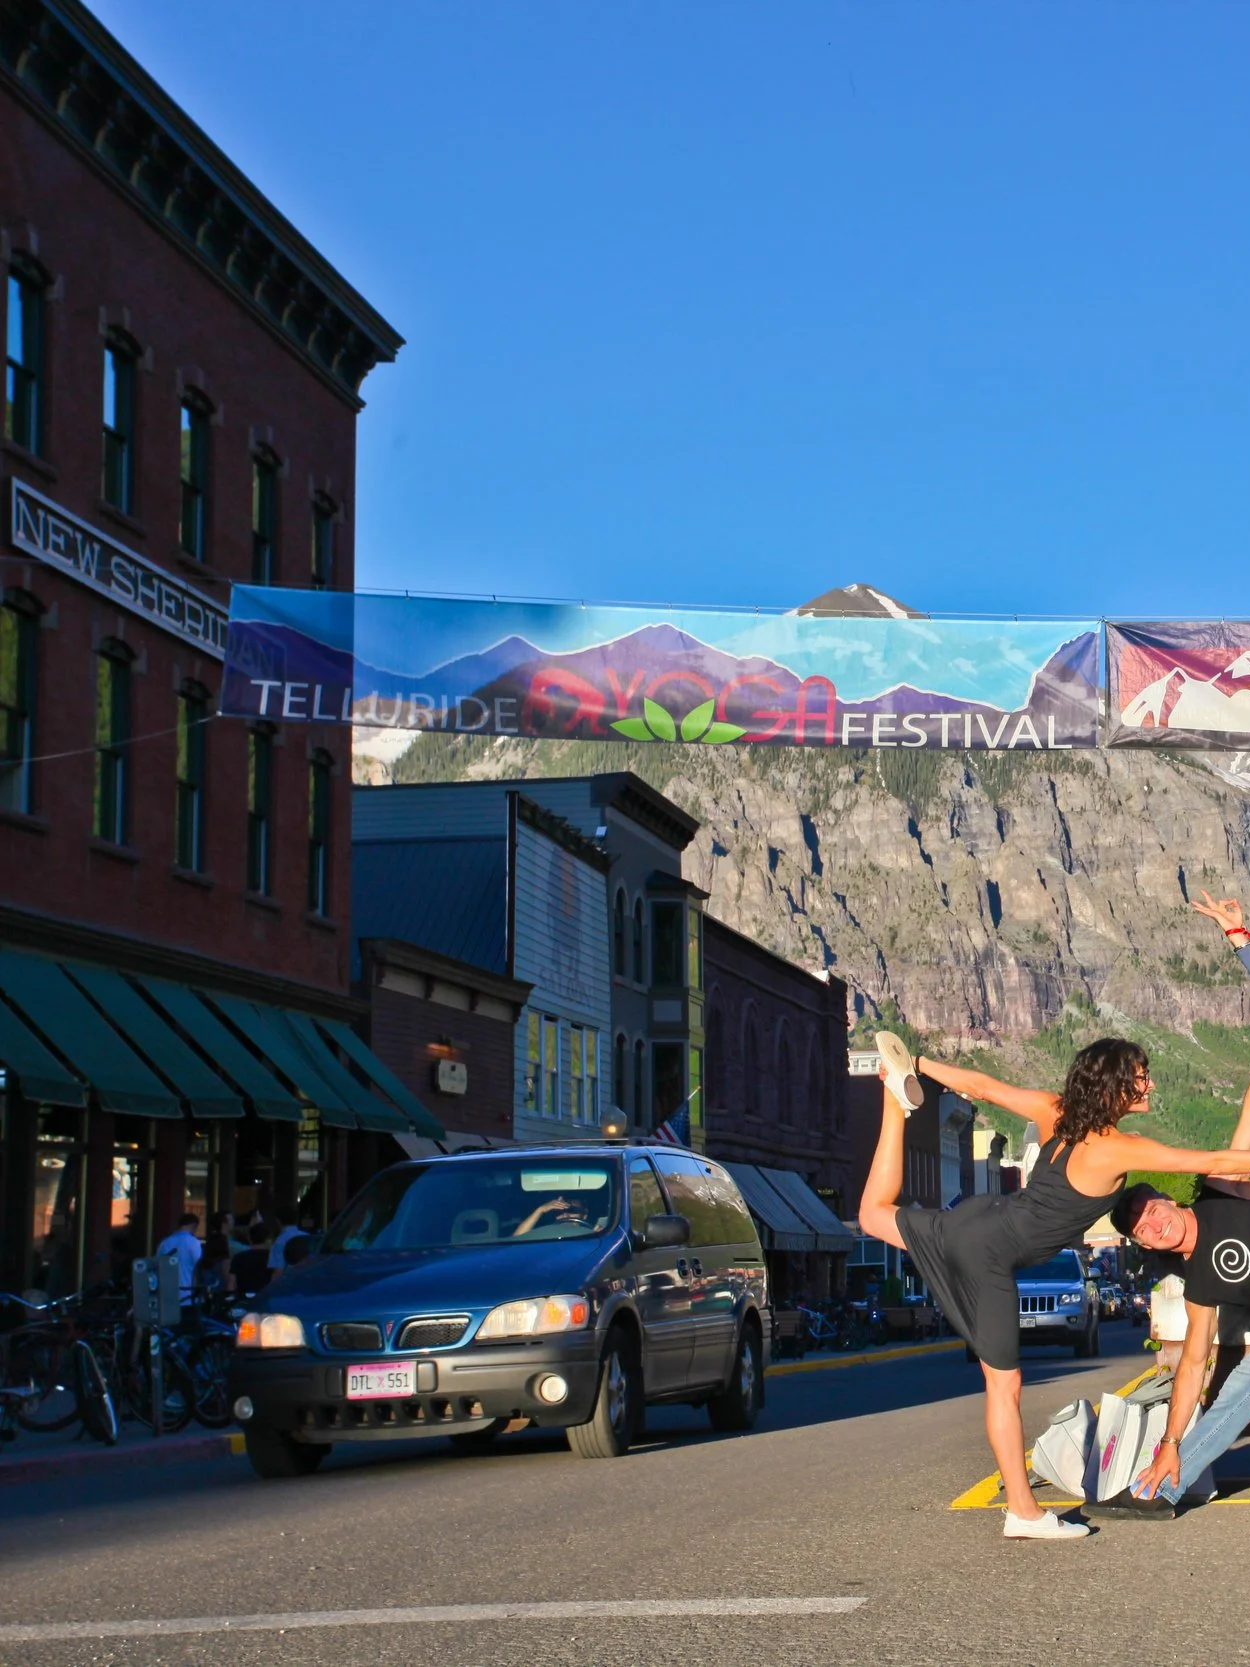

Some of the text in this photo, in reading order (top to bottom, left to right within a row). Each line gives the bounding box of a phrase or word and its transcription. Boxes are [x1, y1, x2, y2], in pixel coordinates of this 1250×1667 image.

[17, 498, 101, 579] NEW
[250, 679, 519, 734] TELLURIDE
[841, 713, 1073, 748] FESTIVAL
[351, 1372, 410, 1391] DTL 551
